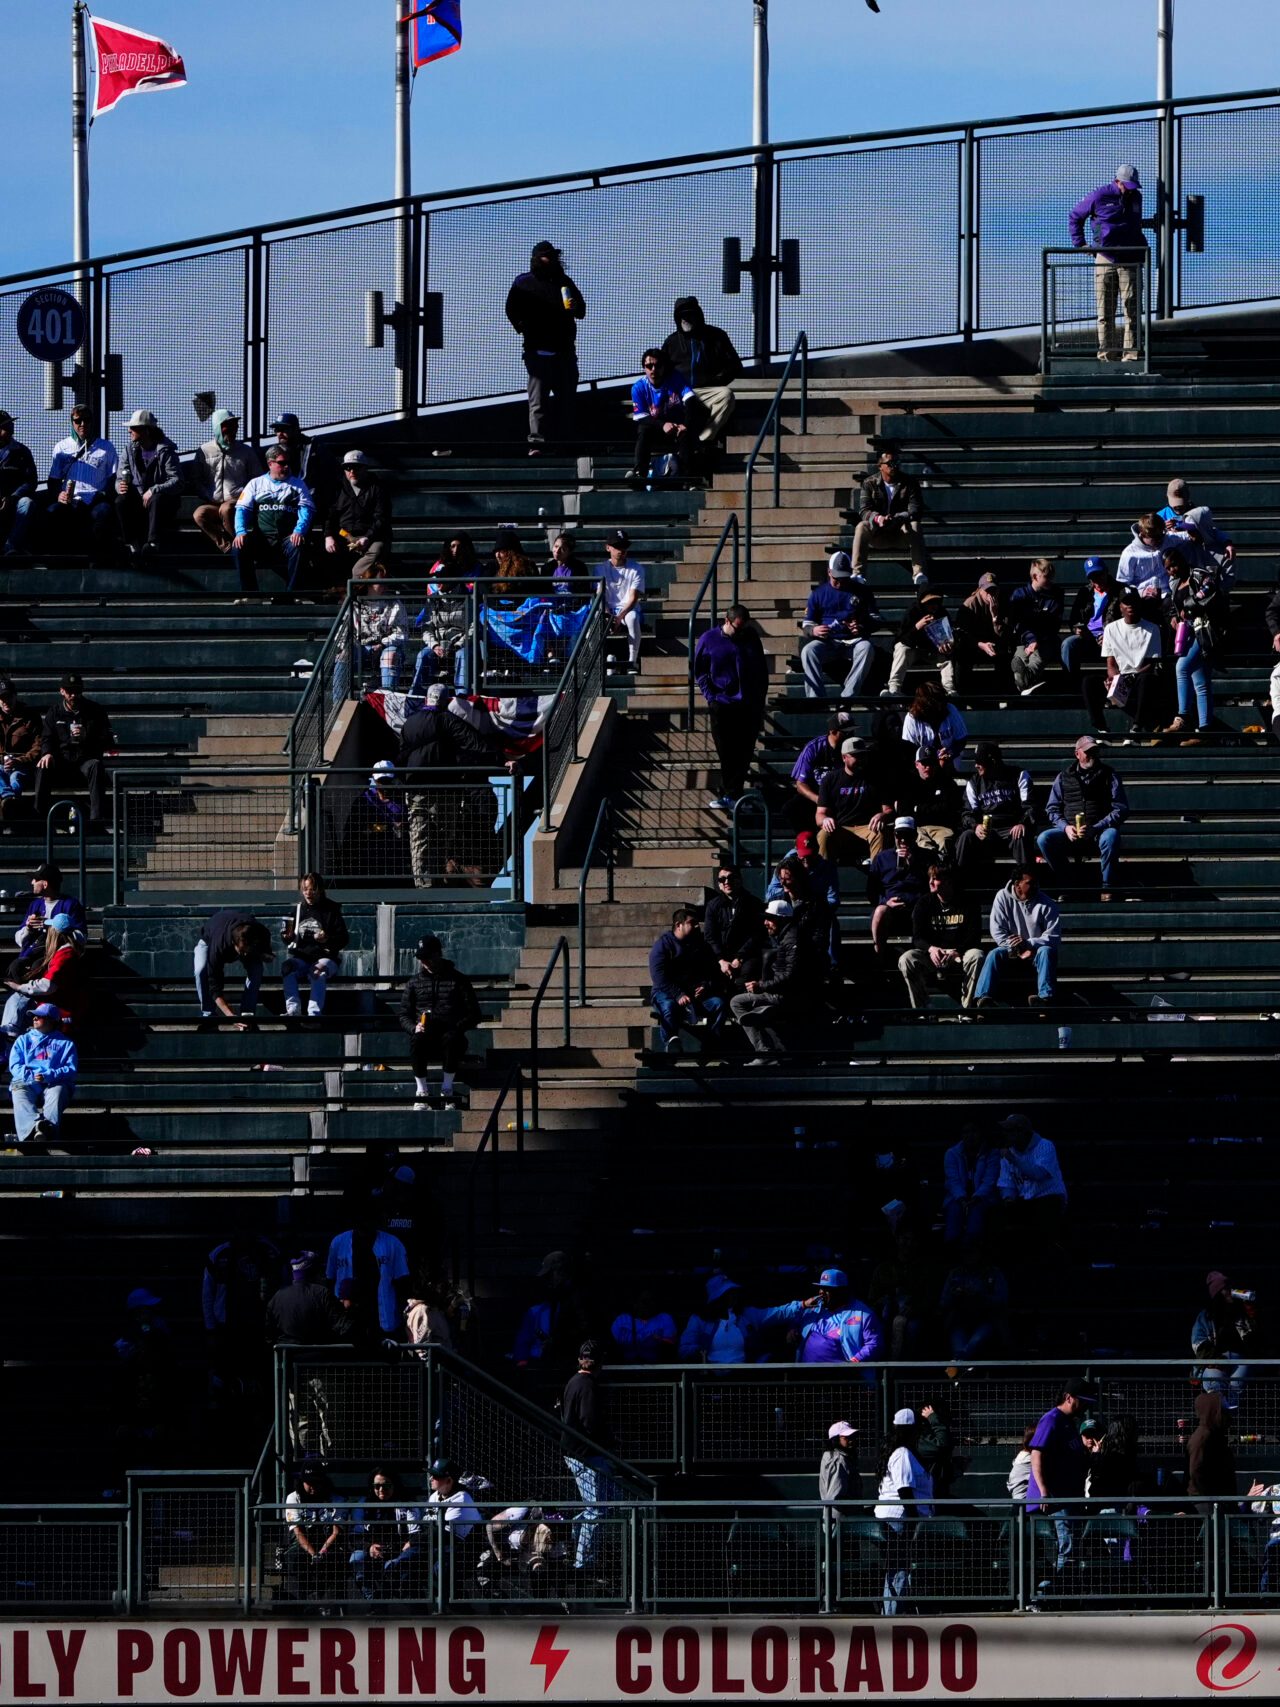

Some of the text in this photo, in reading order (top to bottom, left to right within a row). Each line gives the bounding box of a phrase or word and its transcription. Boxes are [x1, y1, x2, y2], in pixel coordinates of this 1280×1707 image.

[28, 309, 75, 345] 401
[0, 1625, 978, 1697] LY POWERING COLORADO
